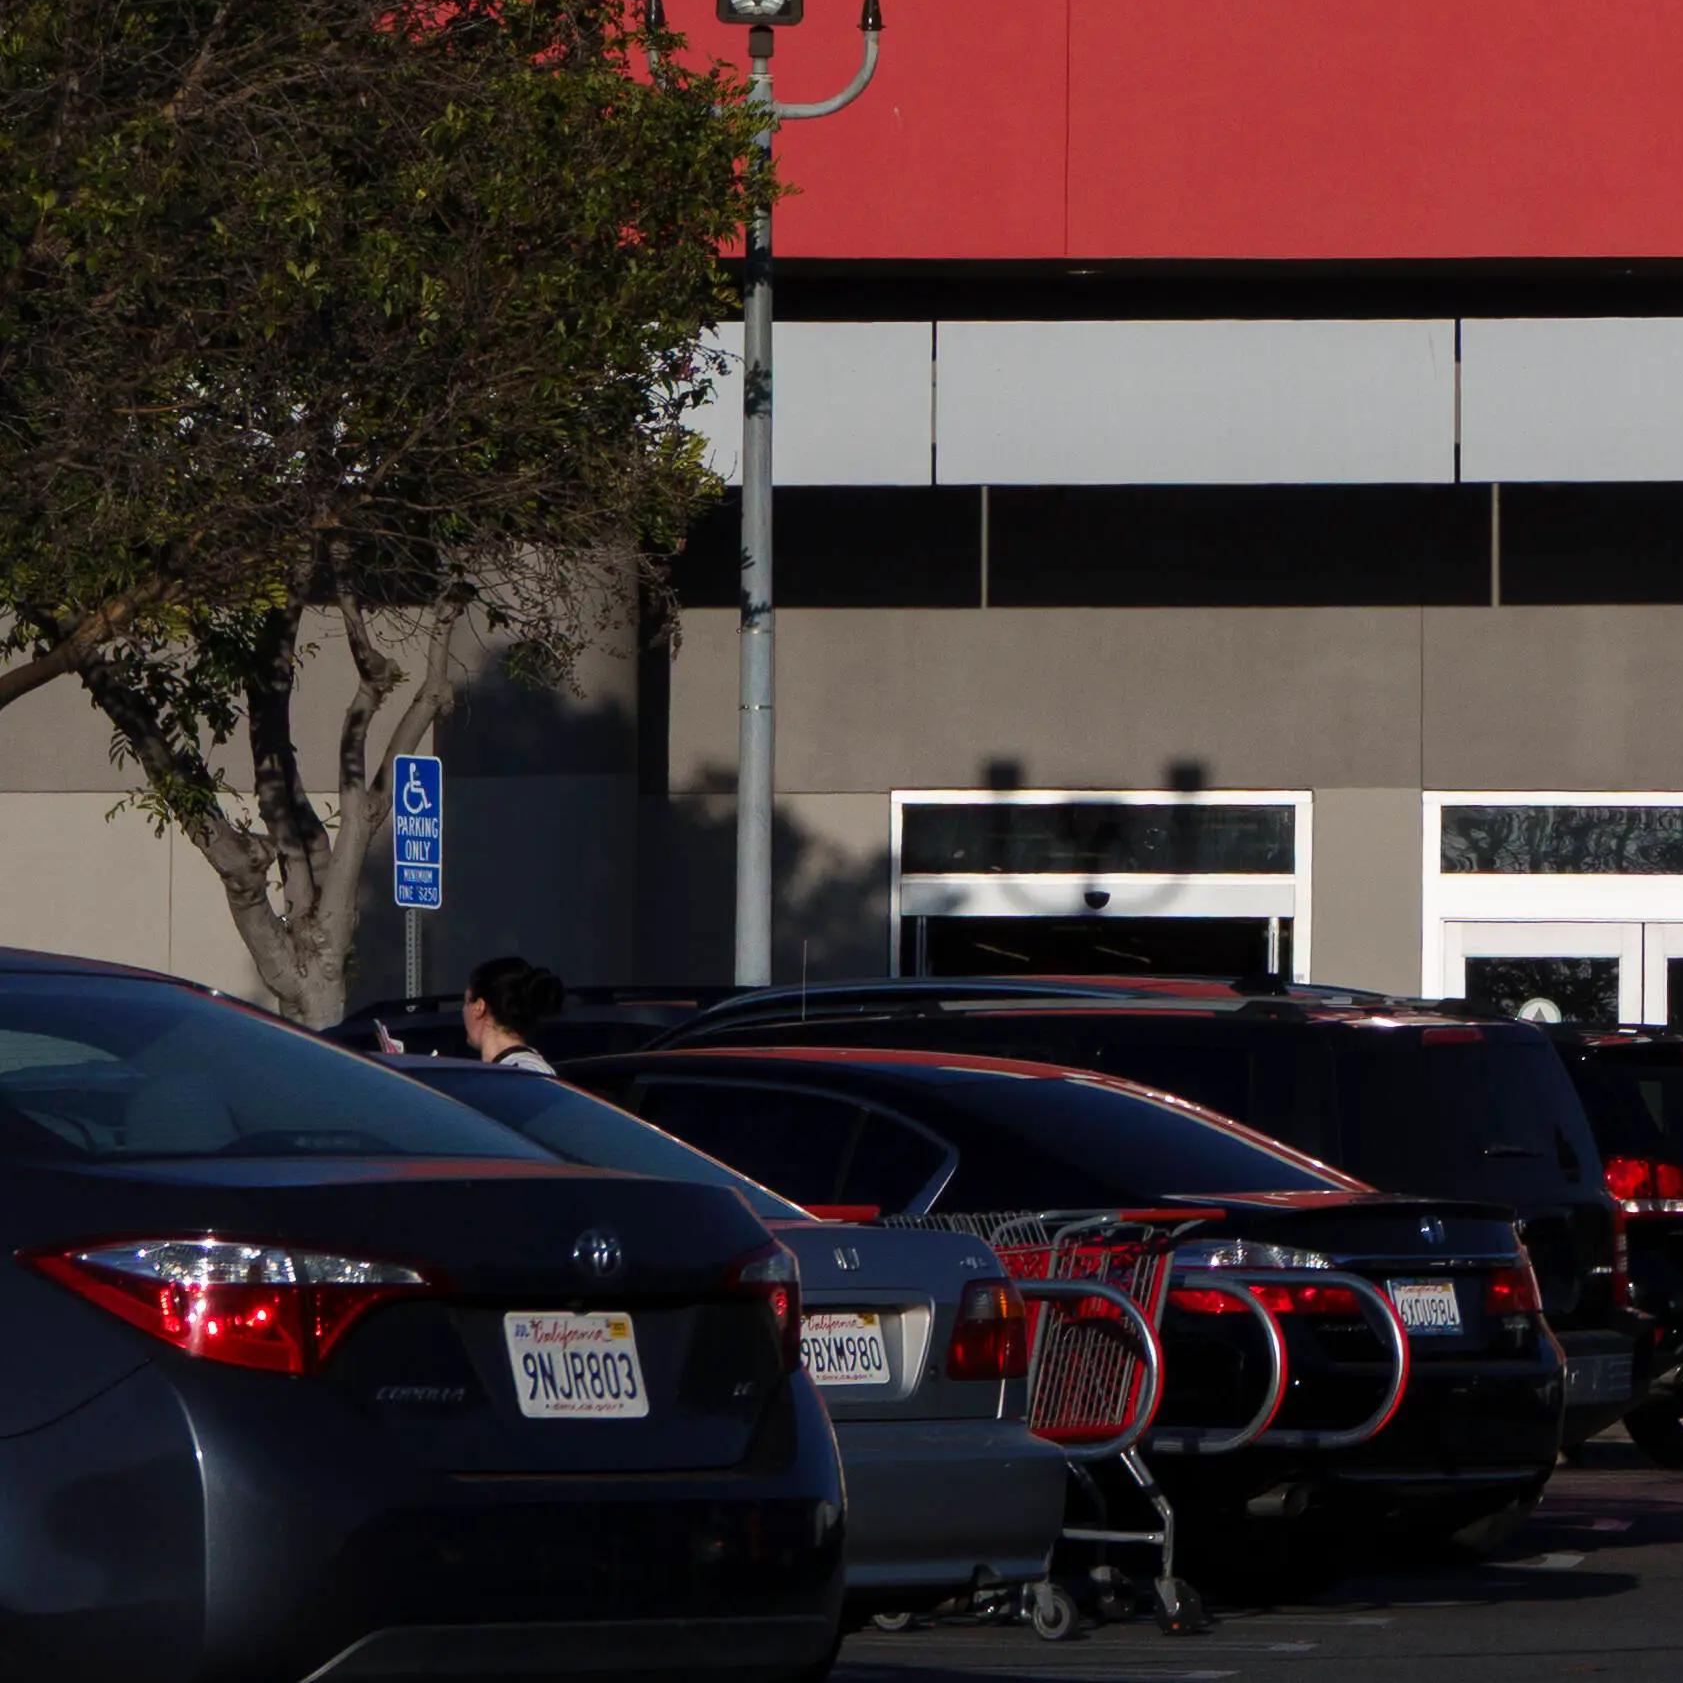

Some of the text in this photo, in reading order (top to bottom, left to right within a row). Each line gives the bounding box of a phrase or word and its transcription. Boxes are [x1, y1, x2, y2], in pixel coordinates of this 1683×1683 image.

[397, 815, 439, 839] PARKING
[405, 839, 431, 862] ONLY
[403, 868, 433, 884] MINIMUM
[399, 885, 437, 902] FINE $250
[532, 1319, 612, 1350] California
[801, 1336, 882, 1372] 9BXM980
[522, 1351, 638, 1400] 9NJR803
